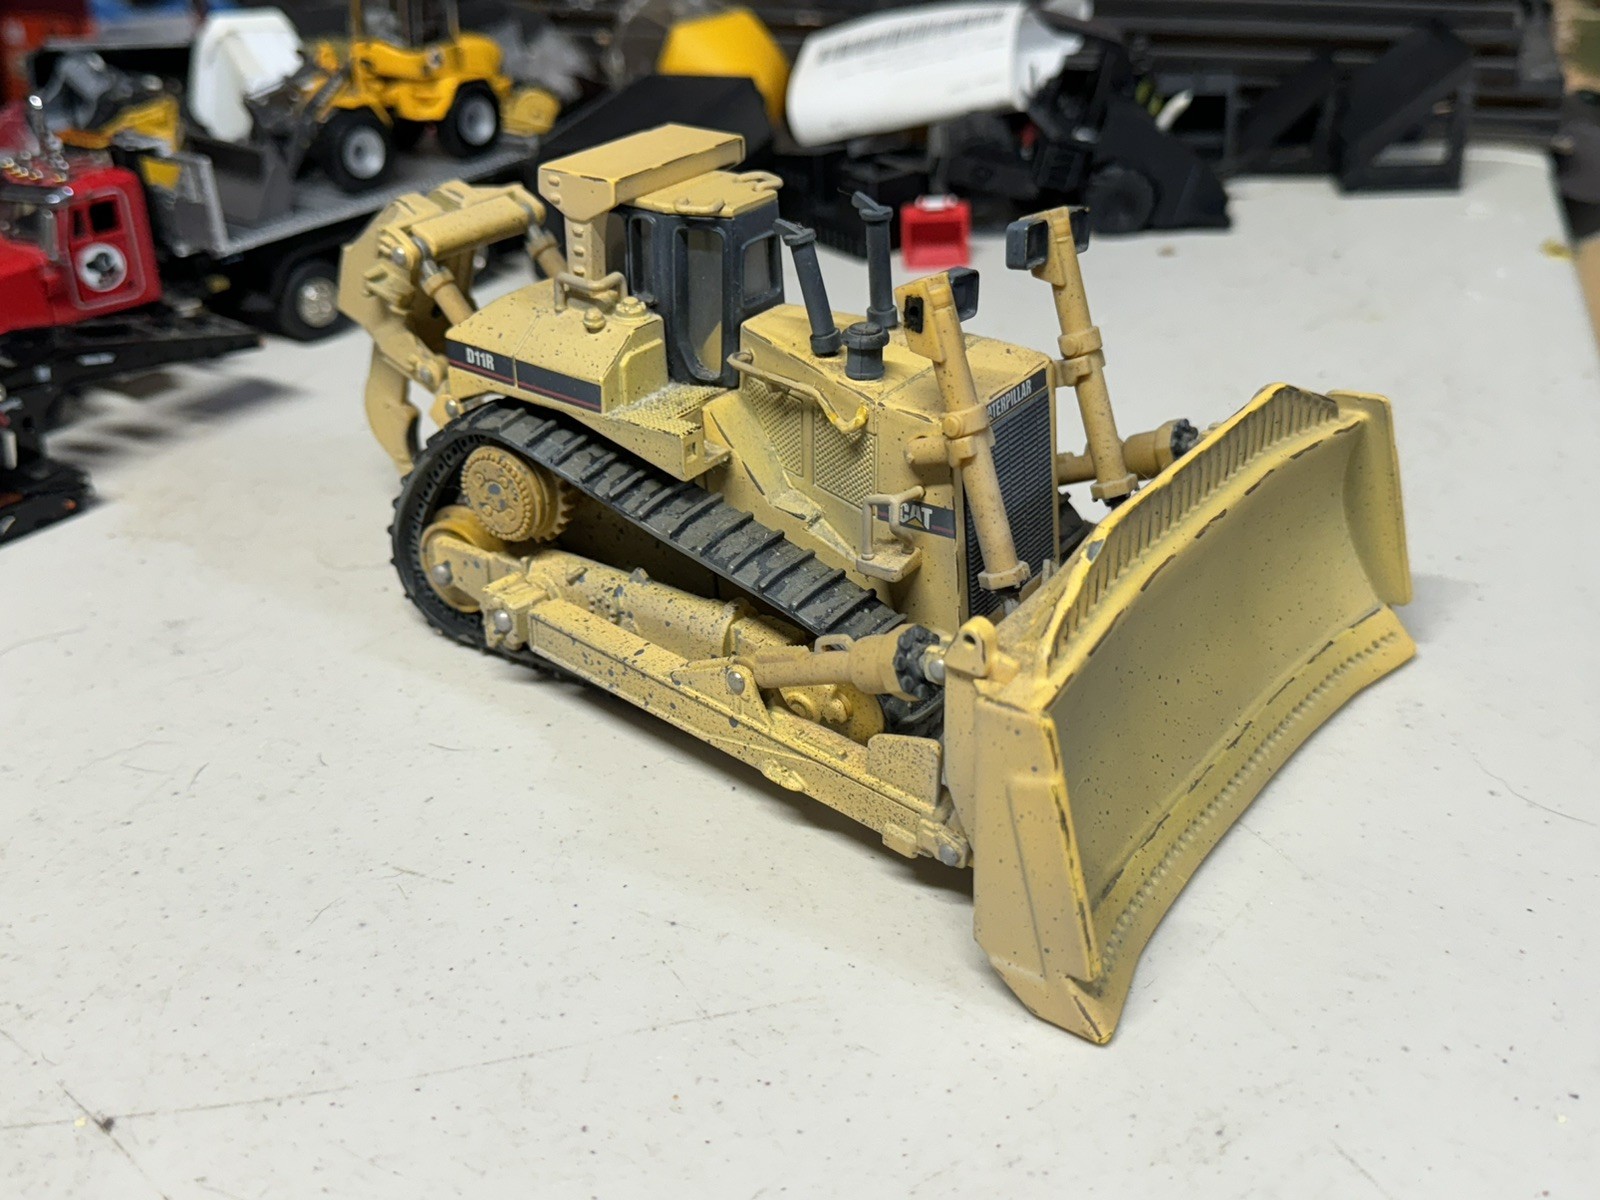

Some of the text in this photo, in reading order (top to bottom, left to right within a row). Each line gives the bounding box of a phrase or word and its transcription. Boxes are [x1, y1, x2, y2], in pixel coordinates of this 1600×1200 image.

[466, 347, 495, 371] D11R
[987, 379, 1032, 418] ATERPILLAR
[900, 502, 933, 530] CAT
